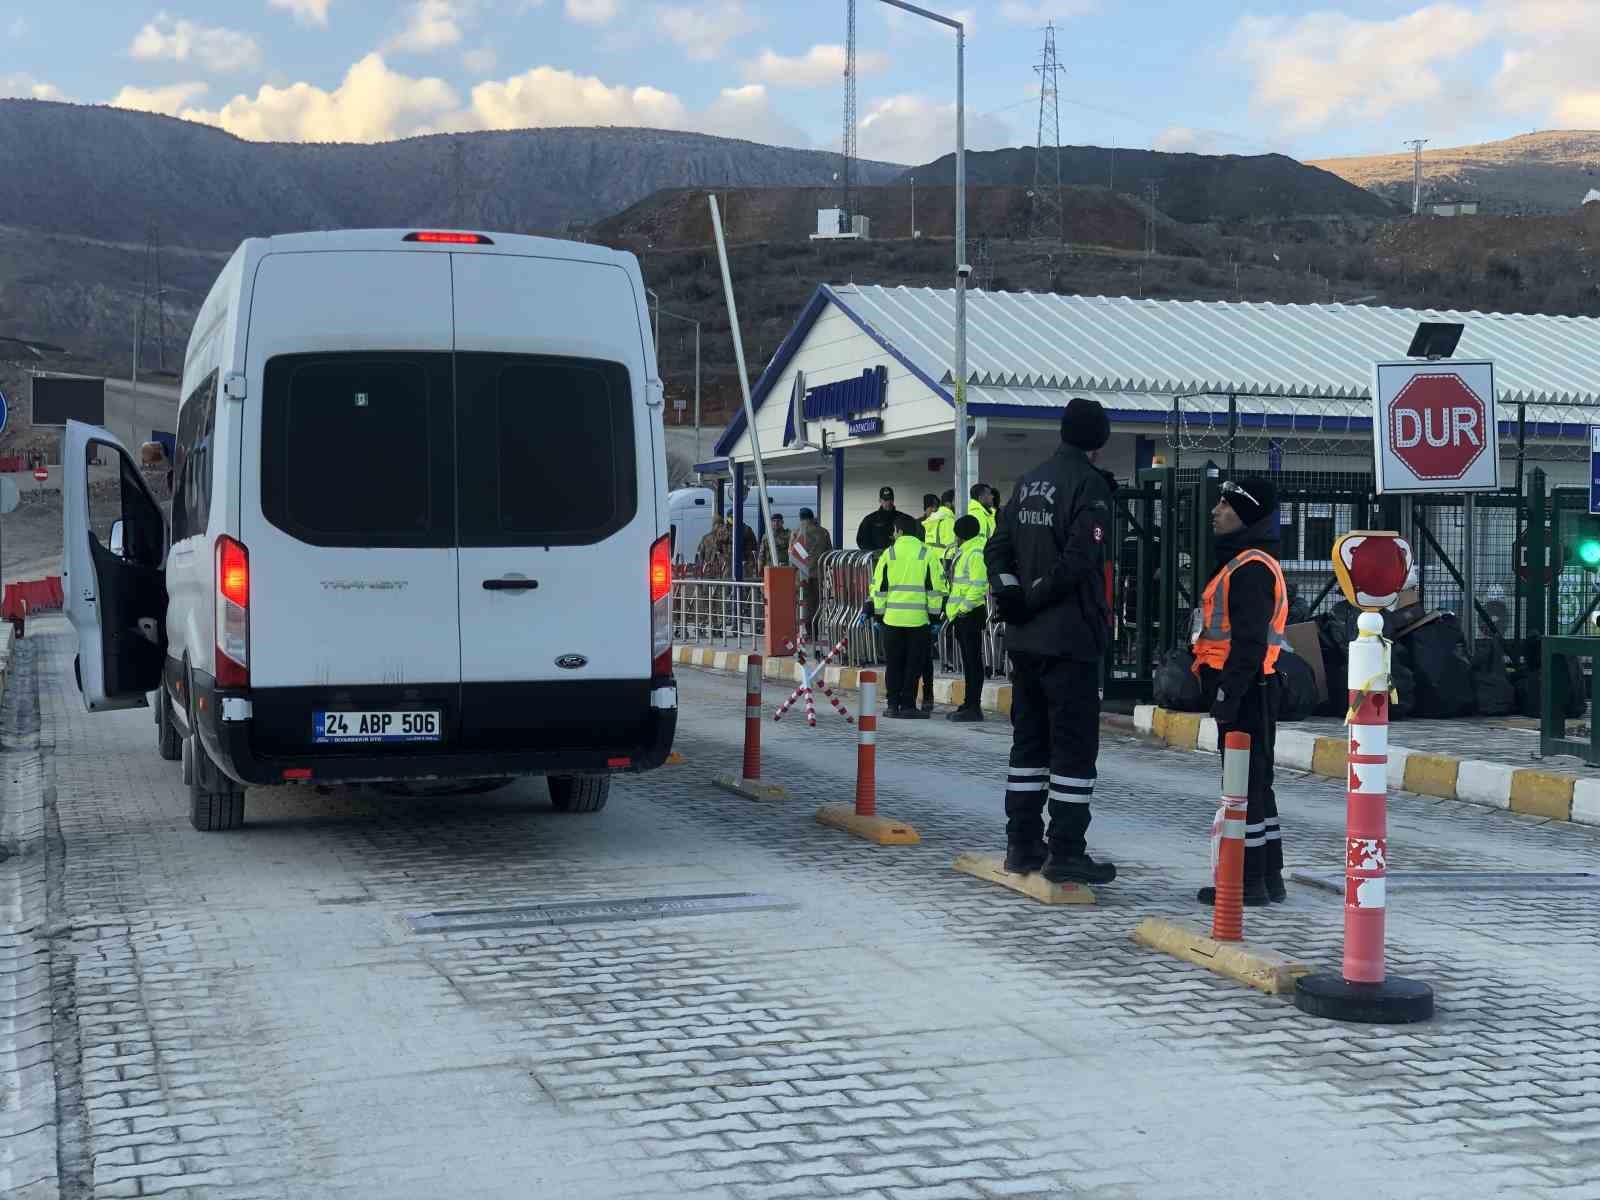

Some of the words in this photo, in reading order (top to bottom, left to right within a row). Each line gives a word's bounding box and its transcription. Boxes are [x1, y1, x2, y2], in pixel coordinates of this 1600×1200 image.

[1395, 407, 1480, 447] DUR
[326, 714, 349, 734] 24
[359, 713, 392, 734] ABP
[401, 713, 435, 734] 506
